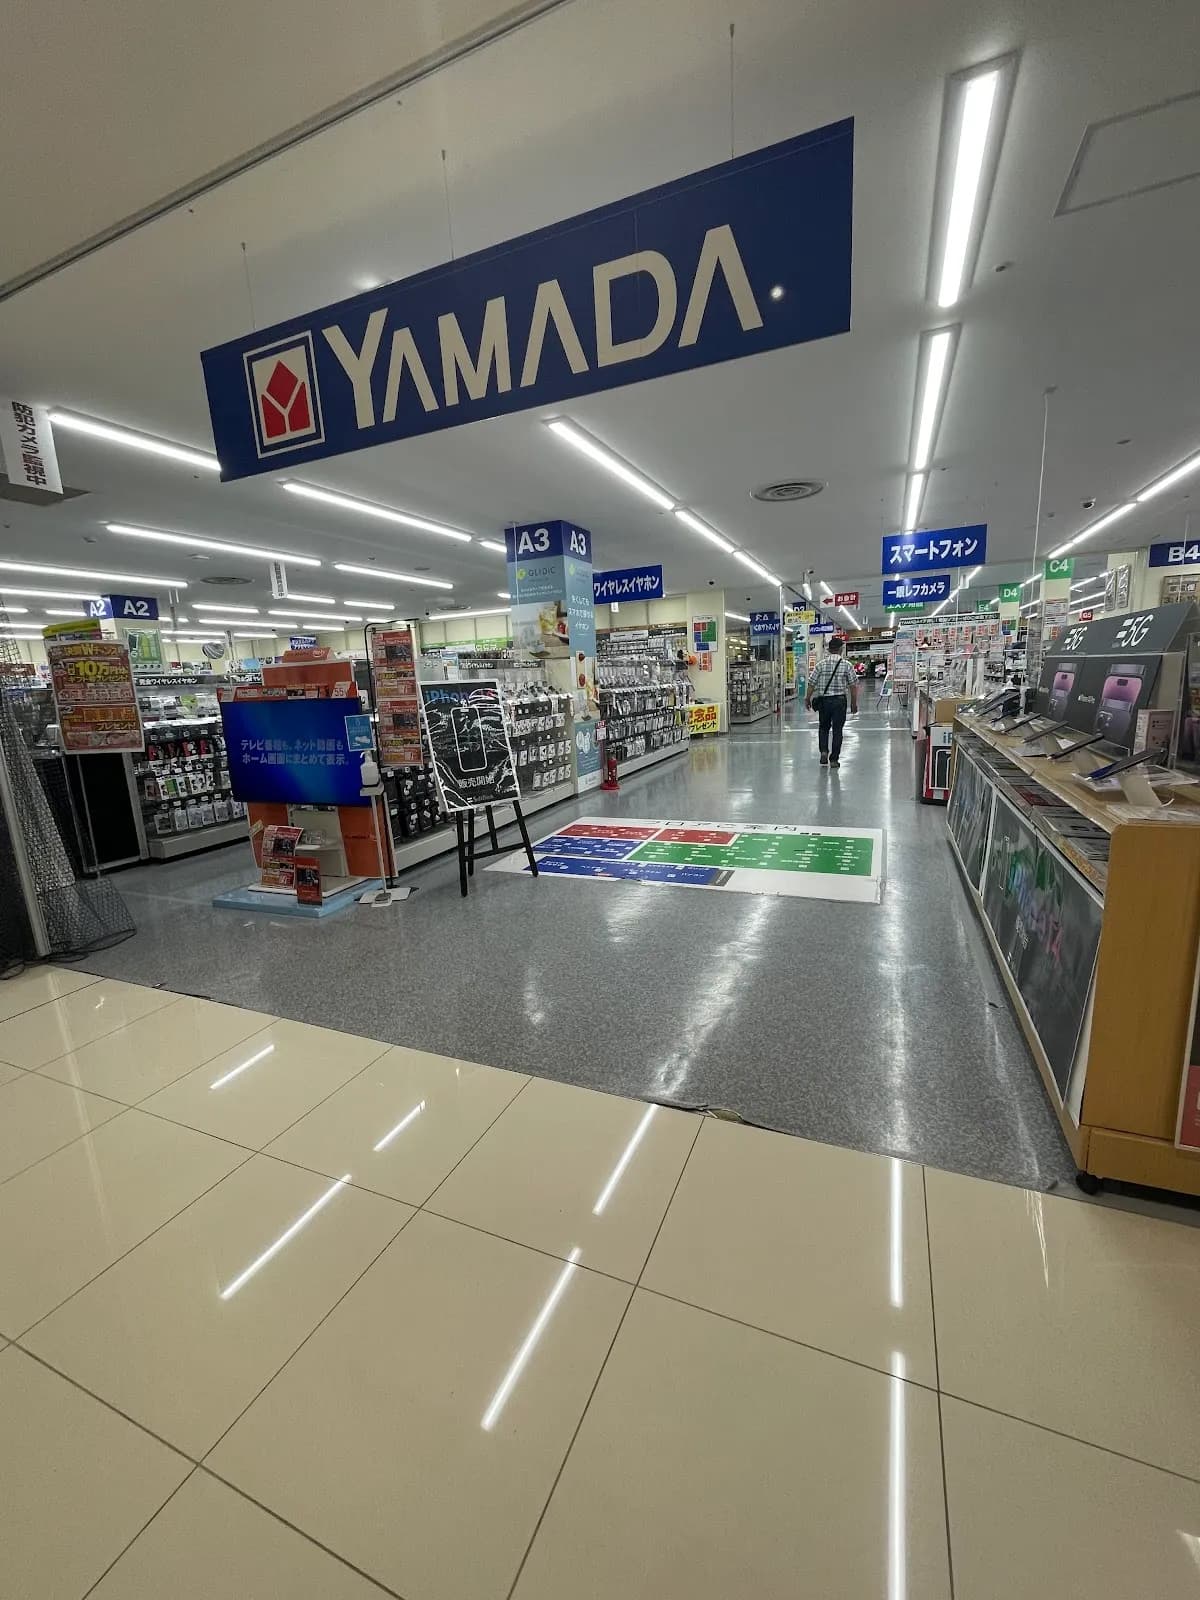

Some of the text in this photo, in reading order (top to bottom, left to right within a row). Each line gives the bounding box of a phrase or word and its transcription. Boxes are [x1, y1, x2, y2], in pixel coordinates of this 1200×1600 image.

[322, 224, 764, 429] YAMADA
[518, 528, 550, 554] A3
[570, 530, 586, 555] A3
[889, 538, 978, 564] スマートフォン
[1168, 545, 1200, 562] B4
[528, 566, 556, 577] GLIDIC
[1050, 560, 1069, 572] C4
[593, 575, 660, 598] ワイヤレスイヤホン
[1003, 589, 1018, 598] D4
[90, 602, 106, 617] A2
[123, 601, 150, 616] A2
[978, 603, 990, 611] E4
